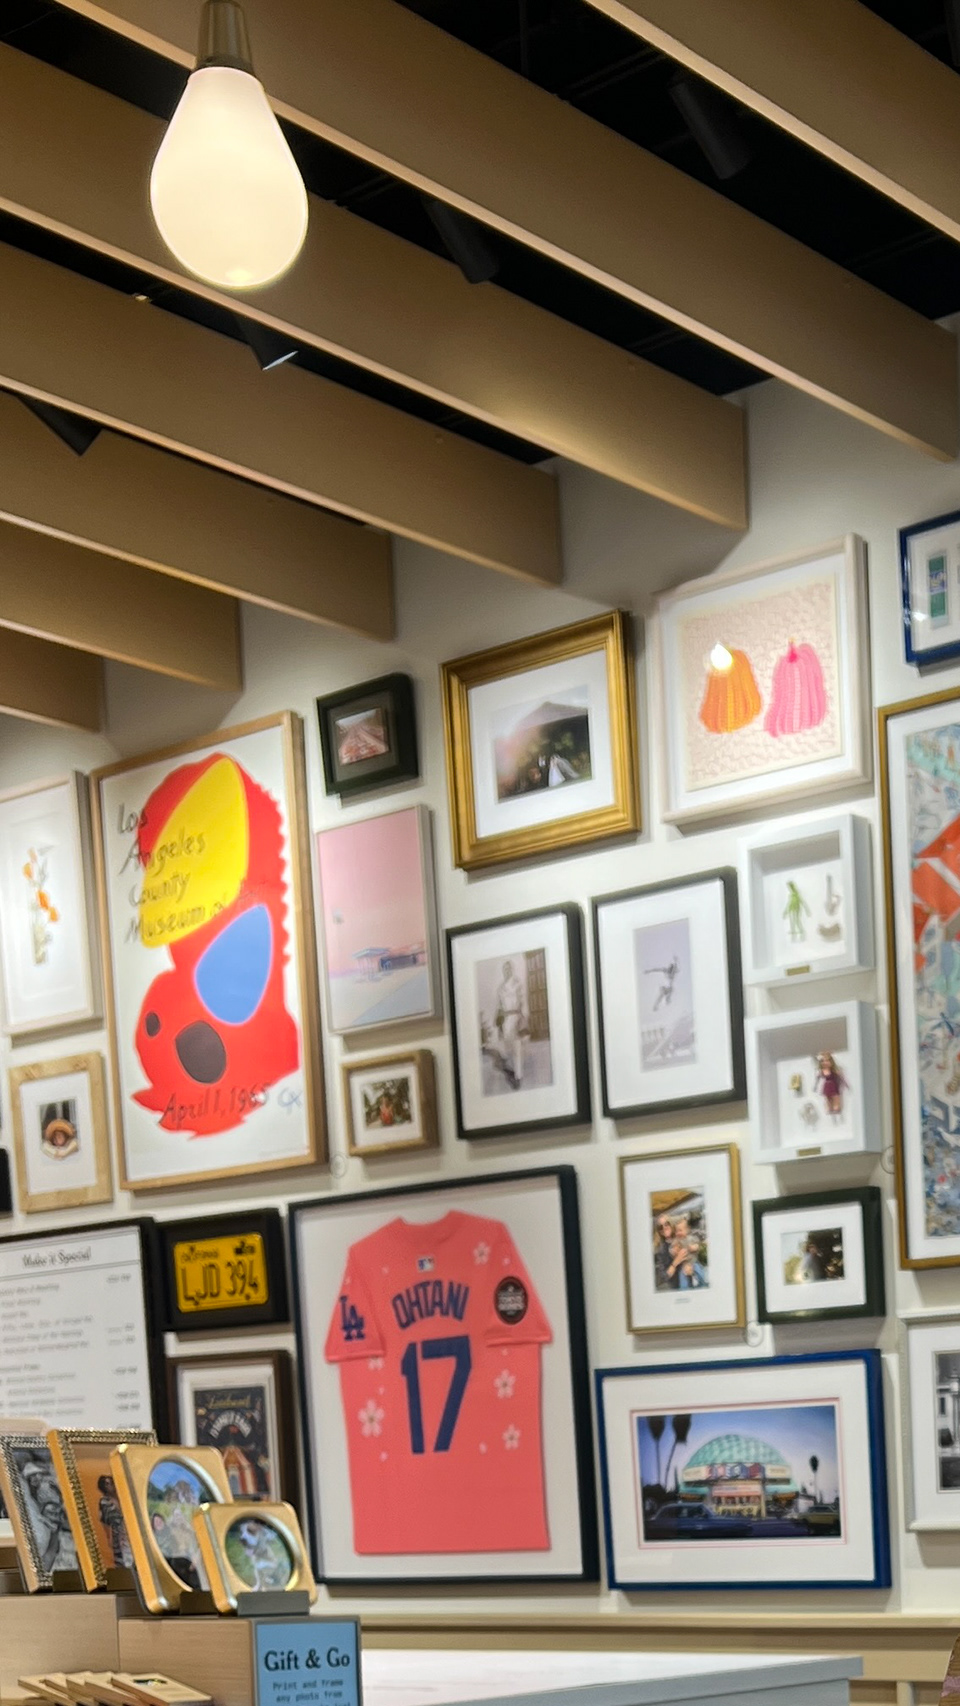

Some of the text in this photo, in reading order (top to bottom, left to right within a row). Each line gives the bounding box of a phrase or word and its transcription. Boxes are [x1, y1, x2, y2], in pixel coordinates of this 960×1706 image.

[117, 804, 147, 833] Los
[119, 827, 206, 877] Angeles
[129, 871, 190, 907] County
[124, 906, 205, 943] Museum
[158, 1088, 209, 1130] April
[226, 1260, 258, 1296] 394
[339, 1295, 365, 1341] LA
[392, 1279, 469, 1330] OHTANI
[401, 1334, 472, 1454] 17
[264, 1646, 351, 1672] Gift & Go
[273, 1679, 344, 1691] Print and frame
[276, 1690, 343, 1703] any photo from
